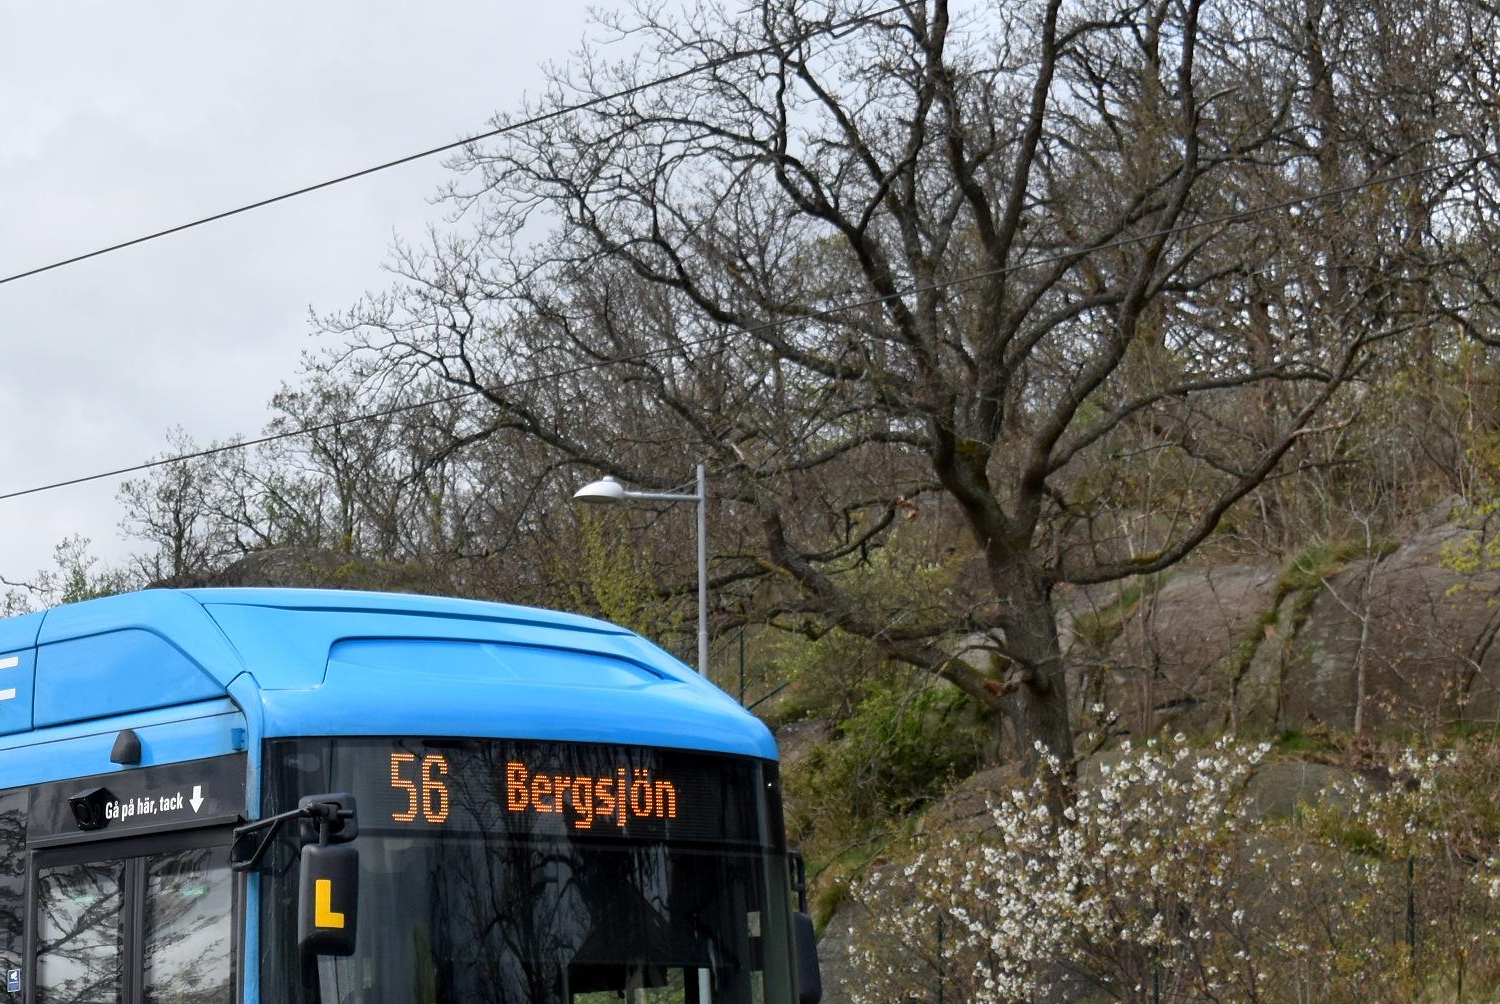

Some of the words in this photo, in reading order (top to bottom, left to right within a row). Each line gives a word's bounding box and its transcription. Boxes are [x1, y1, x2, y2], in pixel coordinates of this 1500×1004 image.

[105, 800, 120, 819] Gå
[121, 798, 134, 821] på
[136, 796, 157, 814] här,
[159, 792, 183, 811] tack
[390, 753, 448, 823] 56
[506, 762, 677, 829] Bergsjön
[315, 879, 345, 929] L
